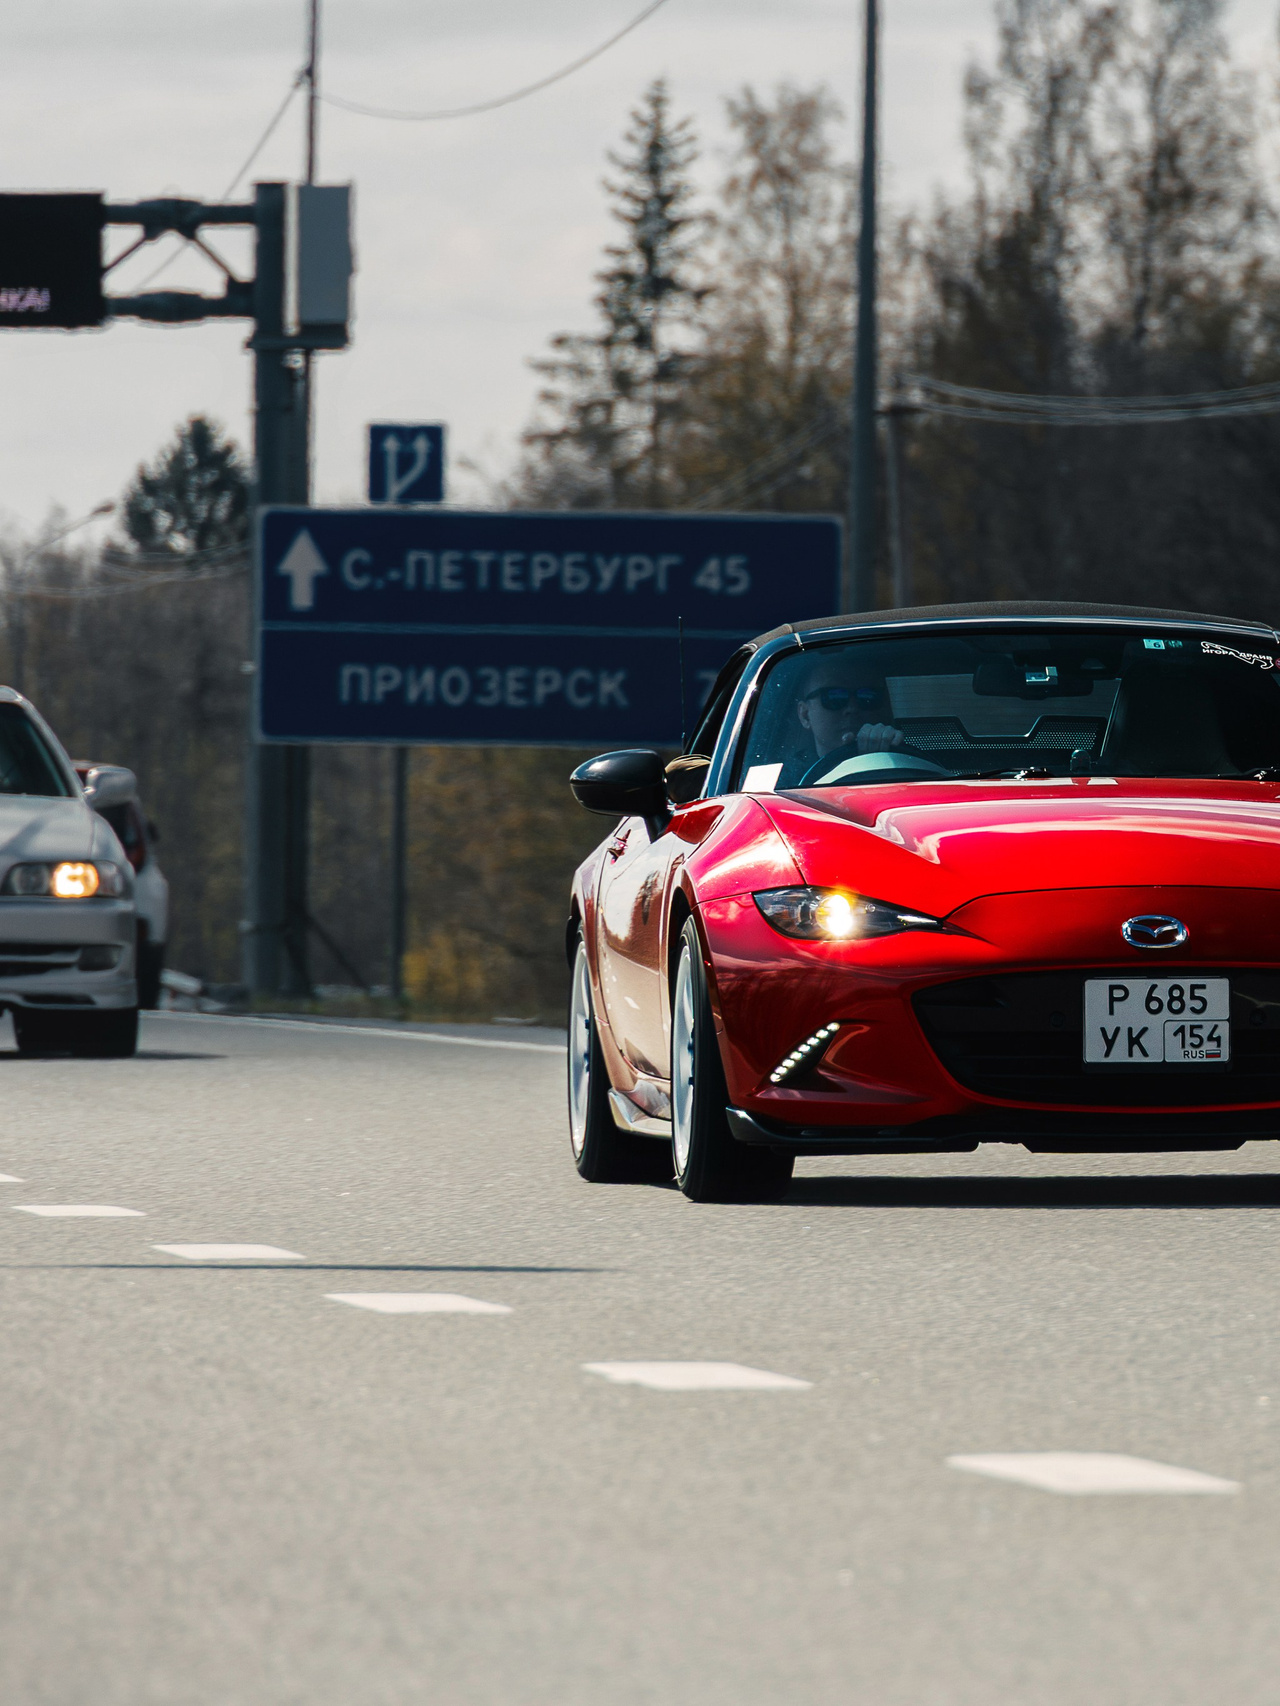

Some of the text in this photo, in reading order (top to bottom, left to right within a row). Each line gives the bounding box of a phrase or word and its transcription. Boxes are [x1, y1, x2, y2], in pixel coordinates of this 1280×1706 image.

[341, 549, 751, 594] С.-ПЕТЕРБУРГ 45
[340, 663, 630, 706] ПРИОЗЕРСК
[1108, 983, 1208, 1016] Р 685
[1100, 1026, 1149, 1058] УК
[1172, 1024, 1222, 1049] 154
[1183, 1050, 1205, 1059] RUS
